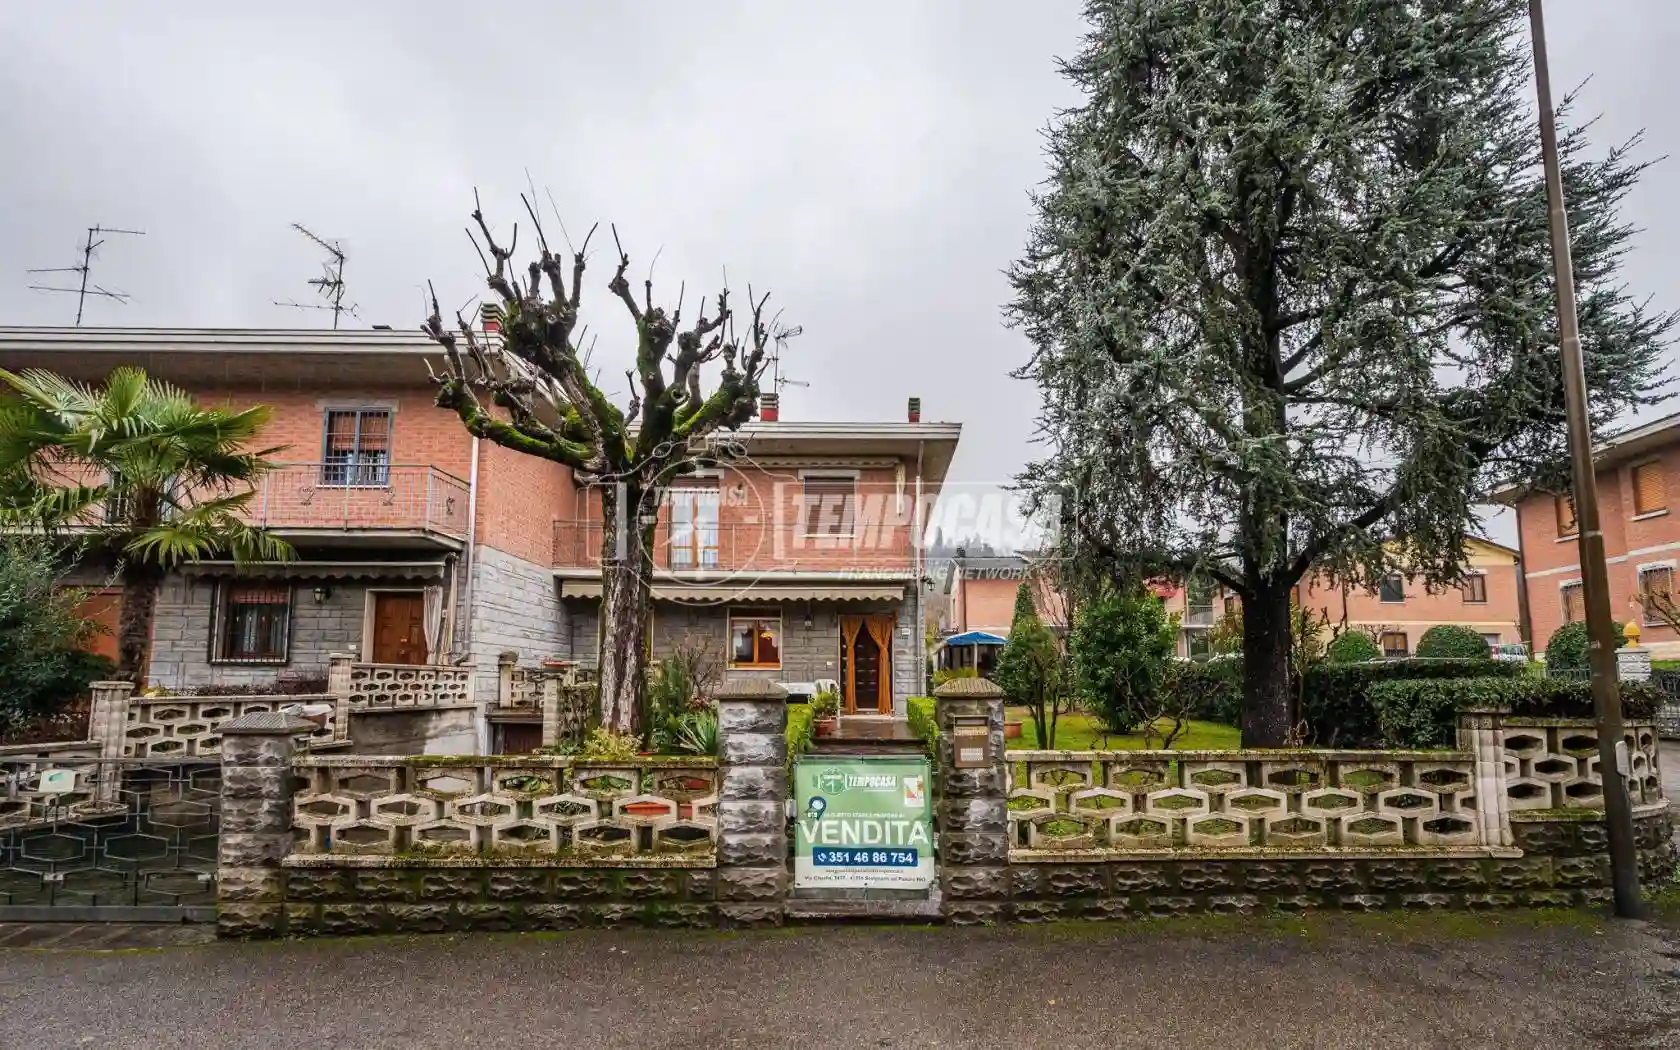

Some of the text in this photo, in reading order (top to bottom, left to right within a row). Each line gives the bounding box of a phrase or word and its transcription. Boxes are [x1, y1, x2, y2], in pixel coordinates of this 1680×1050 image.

[848, 775, 897, 788] TEMPOCASA
[800, 819, 929, 846] VENDITA
[829, 851, 850, 863] 351
[853, 851, 869, 863] 46
[890, 851, 914, 863] 754
